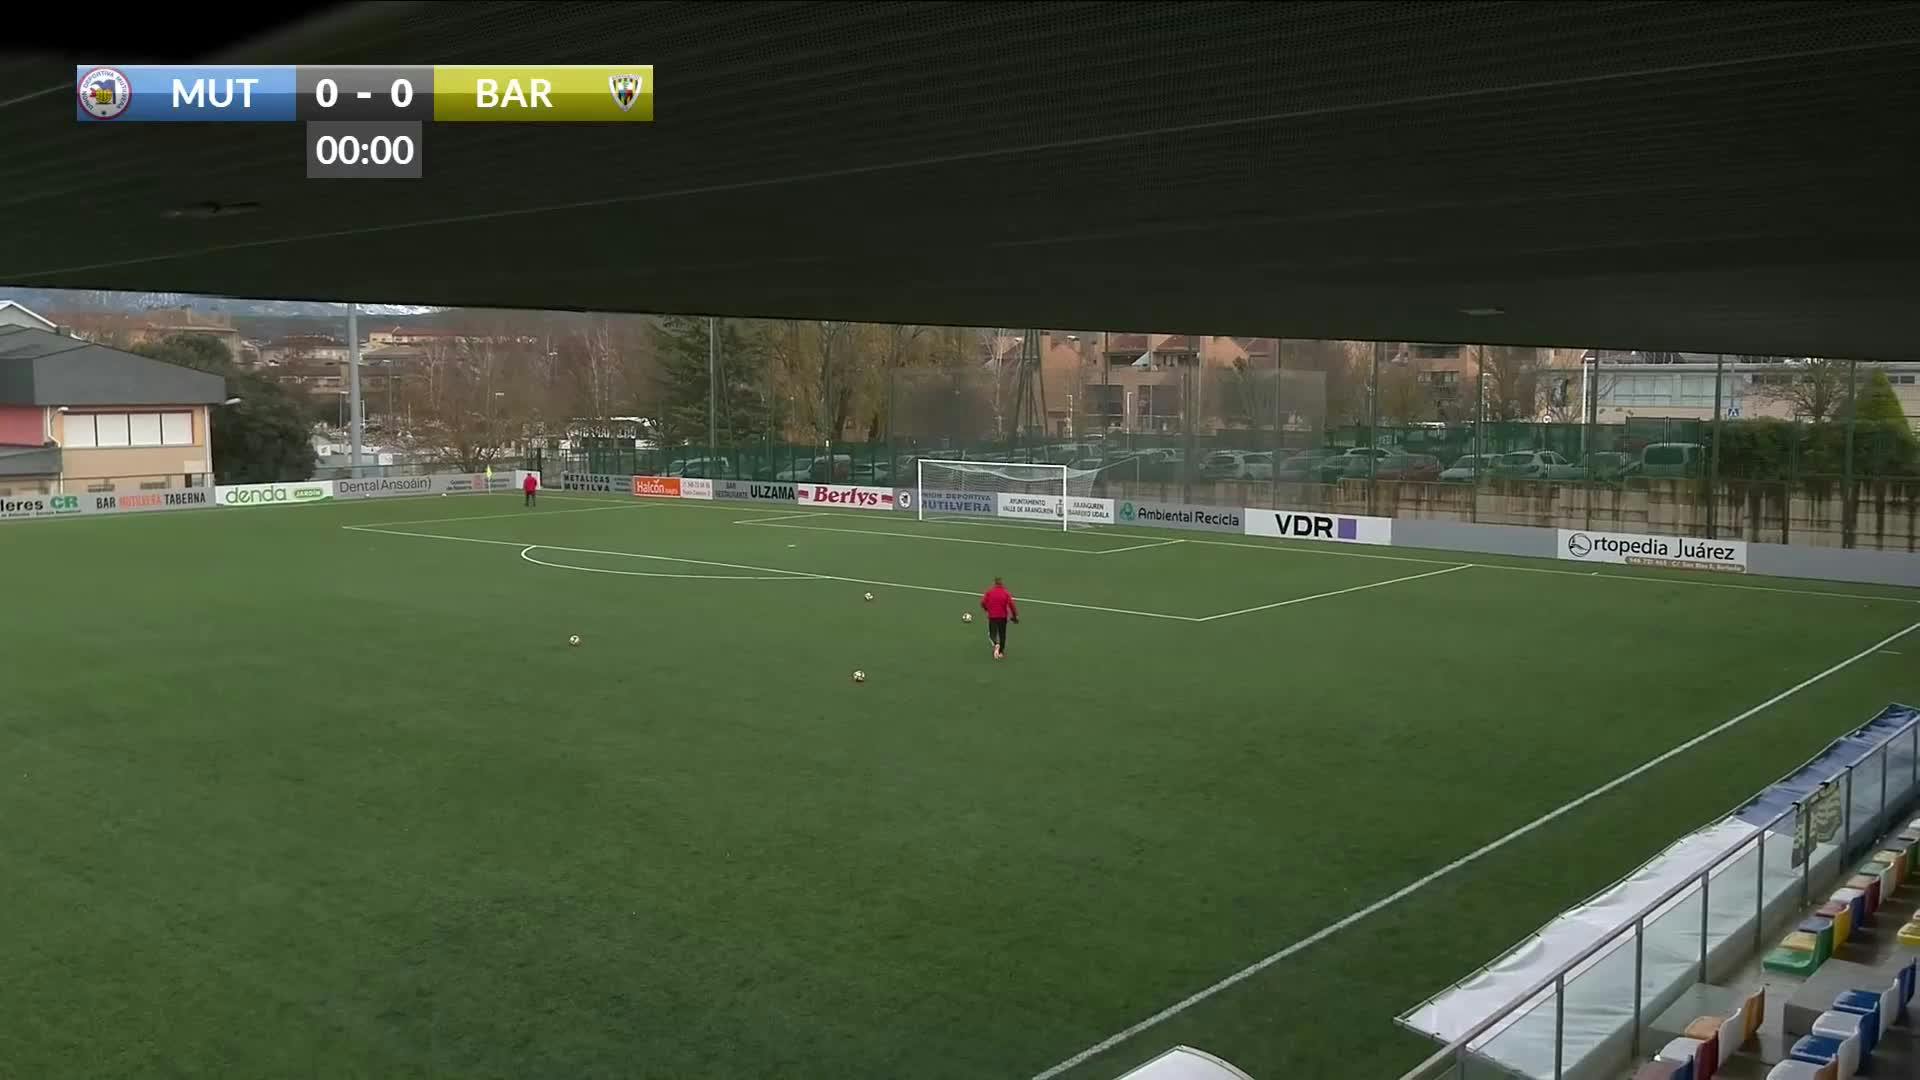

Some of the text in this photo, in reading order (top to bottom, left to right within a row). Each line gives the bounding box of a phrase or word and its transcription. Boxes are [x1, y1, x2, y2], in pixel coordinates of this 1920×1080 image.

[226, 485, 287, 503] denda
[564, 483, 610, 492] MUTILVA
[750, 485, 796, 500] ULZAMA
[813, 486, 879, 506] Berlys
[50, 496, 79, 509] CR
[96, 497, 116, 509] BAR
[164, 492, 206, 505] TABERNA
[1138, 508, 1240, 526] Ambiental Recicla
[1275, 514, 1333, 538] VDR
[1674, 539, 1735, 560] Juárez
